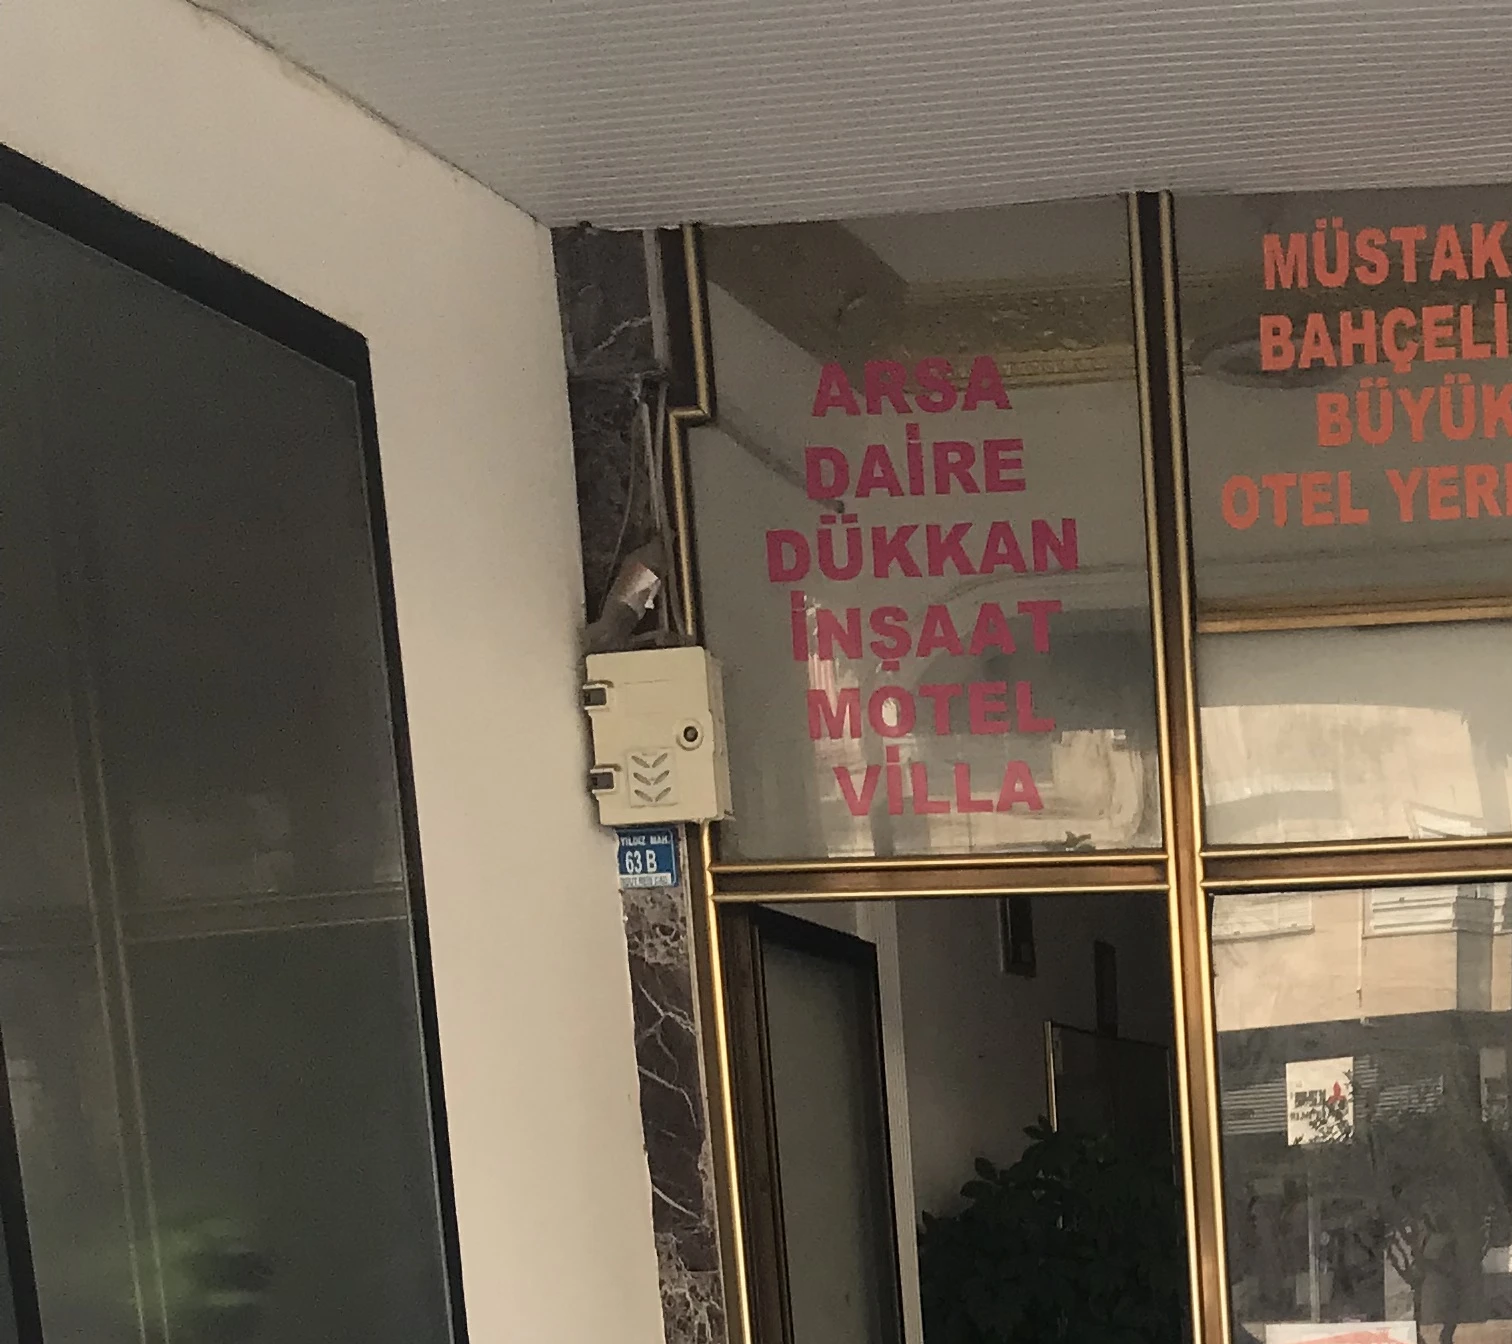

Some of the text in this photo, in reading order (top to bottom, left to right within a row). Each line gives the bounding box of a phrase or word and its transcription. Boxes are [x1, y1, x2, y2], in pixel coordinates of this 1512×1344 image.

[1260, 289, 1510, 373] BAHÇELİ
[812, 355, 1013, 417] ARSA
[804, 423, 1026, 499] DAİRE
[1221, 471, 1370, 530] OTEL
[765, 513, 1079, 583] DÜKKAN
[790, 590, 1063, 671] İNŞAAT
[806, 681, 1057, 741] MOTEL
[833, 746, 1044, 816] VİLLA
[625, 849, 657, 874] 63 B
